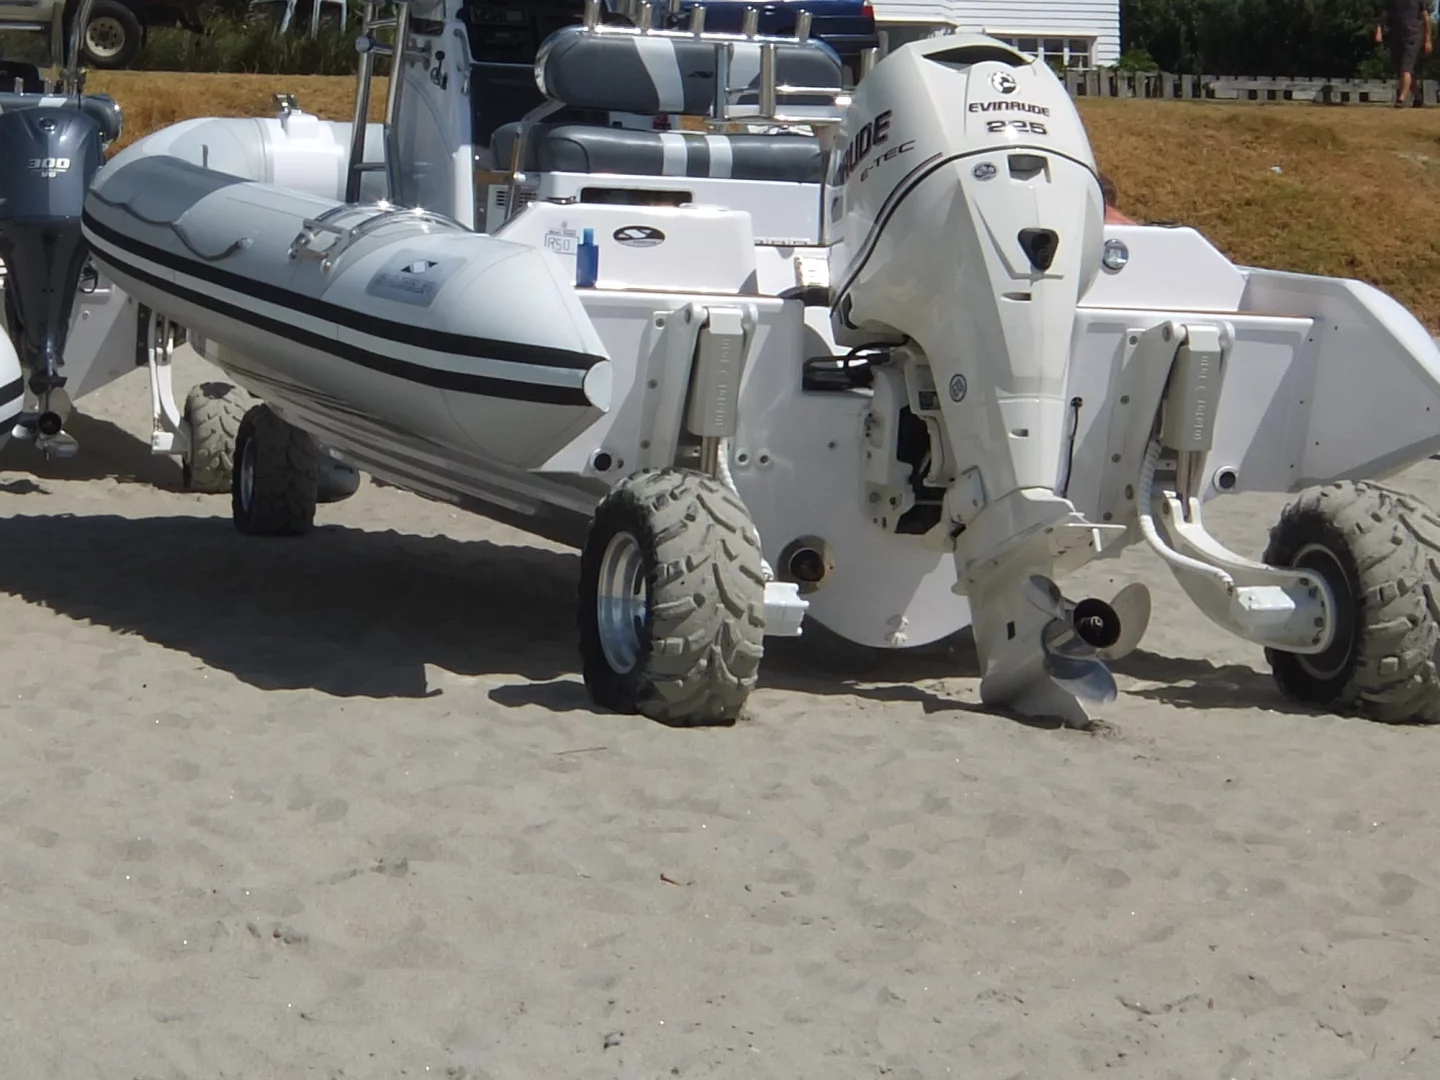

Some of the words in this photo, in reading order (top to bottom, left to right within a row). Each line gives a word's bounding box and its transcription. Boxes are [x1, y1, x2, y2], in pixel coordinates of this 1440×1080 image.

[968, 100, 1050, 118] EVINRUDE
[986, 120, 1048, 136] 225
[28, 157, 71, 169] 300
